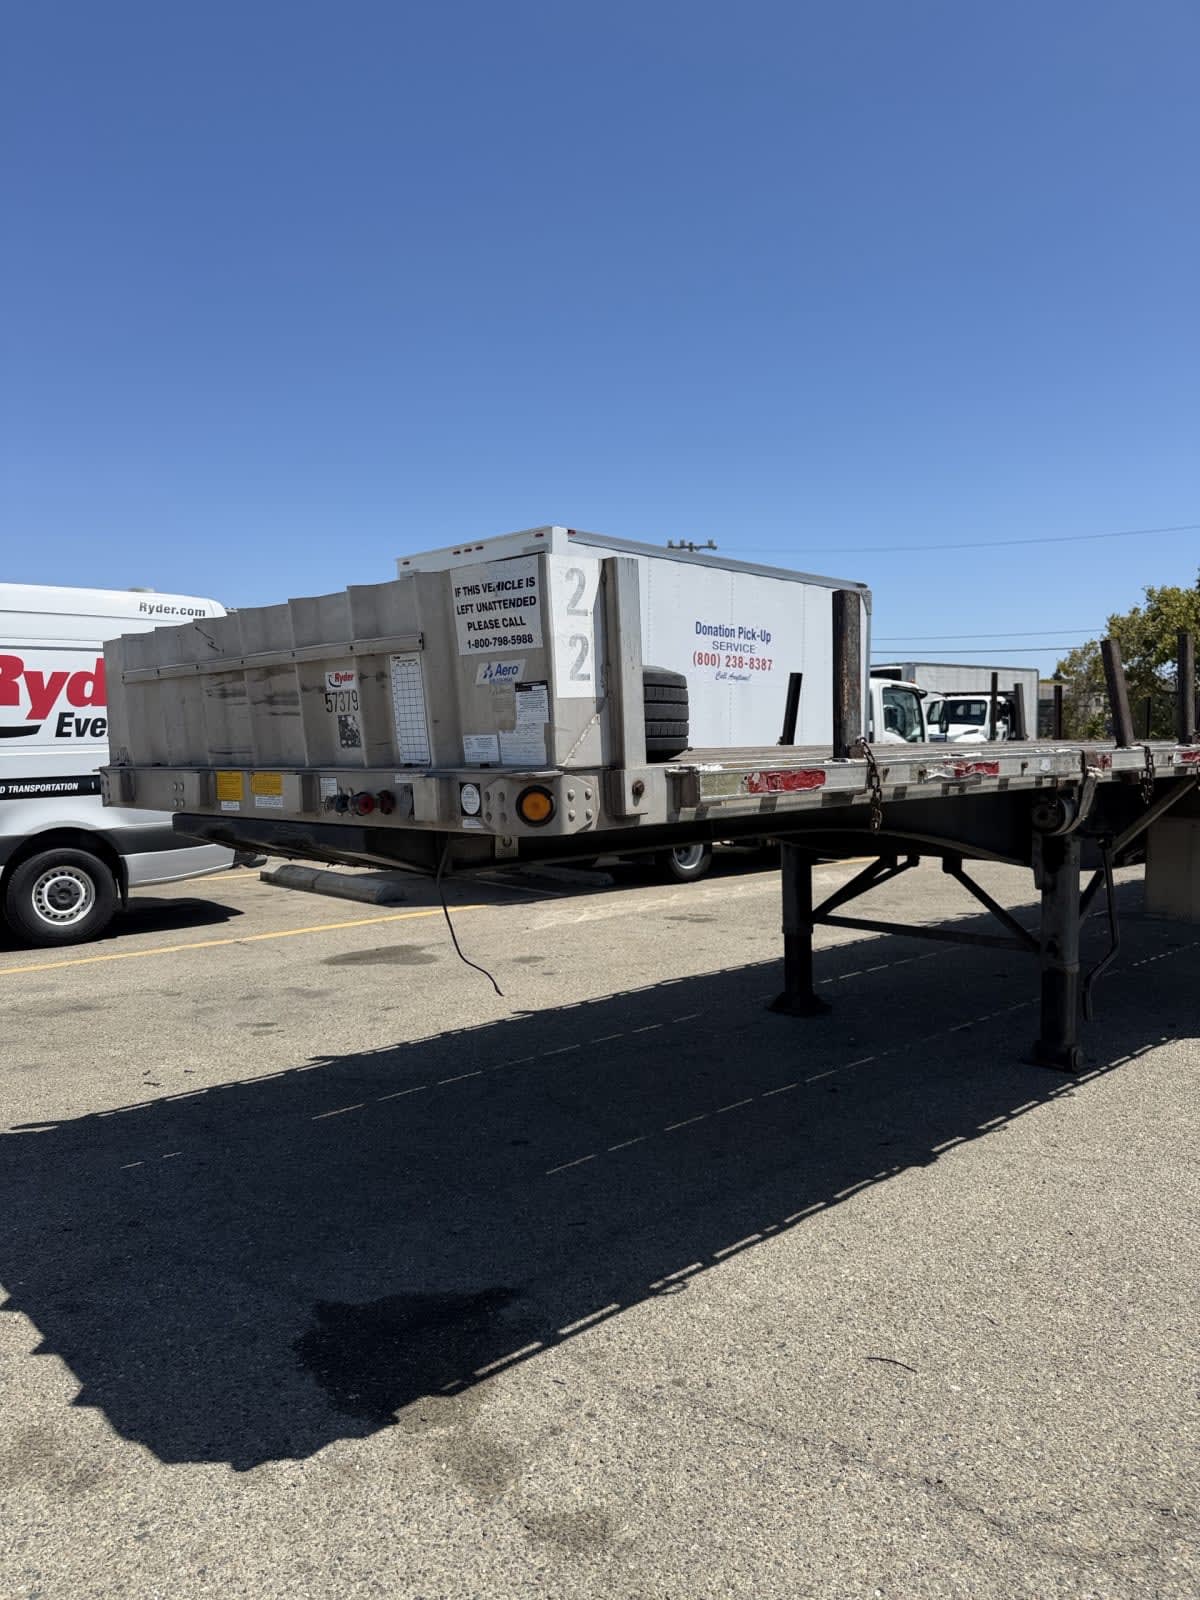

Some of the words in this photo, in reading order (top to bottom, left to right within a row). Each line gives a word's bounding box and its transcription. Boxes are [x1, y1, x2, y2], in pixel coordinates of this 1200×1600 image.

[454, 587, 461, 598] IF
[462, 584, 480, 596] THIS
[481, 579, 524, 593] VEHICLE
[525, 576, 536, 588] IS
[565, 567, 589, 617] 2
[139, 601, 206, 617] Ryder.com
[456, 603, 474, 615] LEFT
[476, 595, 537, 613] UNATTENDED
[467, 619, 500, 632] PLEASE
[501, 615, 527, 628] CALL
[695, 621, 736, 639] Donation
[738, 626, 772, 645] Pick-Up
[467, 633, 534, 649] 1-800-798-5988
[711, 640, 756, 654] SERVICE
[568, 632, 591, 682] 2
[692, 650, 721, 669] (800)
[725, 655, 773, 671] 238-8387
[334, 672, 354, 684] Ryder
[494, 663, 519, 677] Aero
[324, 690, 359, 713] 57379
[55, 711, 109, 738] Eve
[8, 782, 79, 794] TRANSPORTATION
